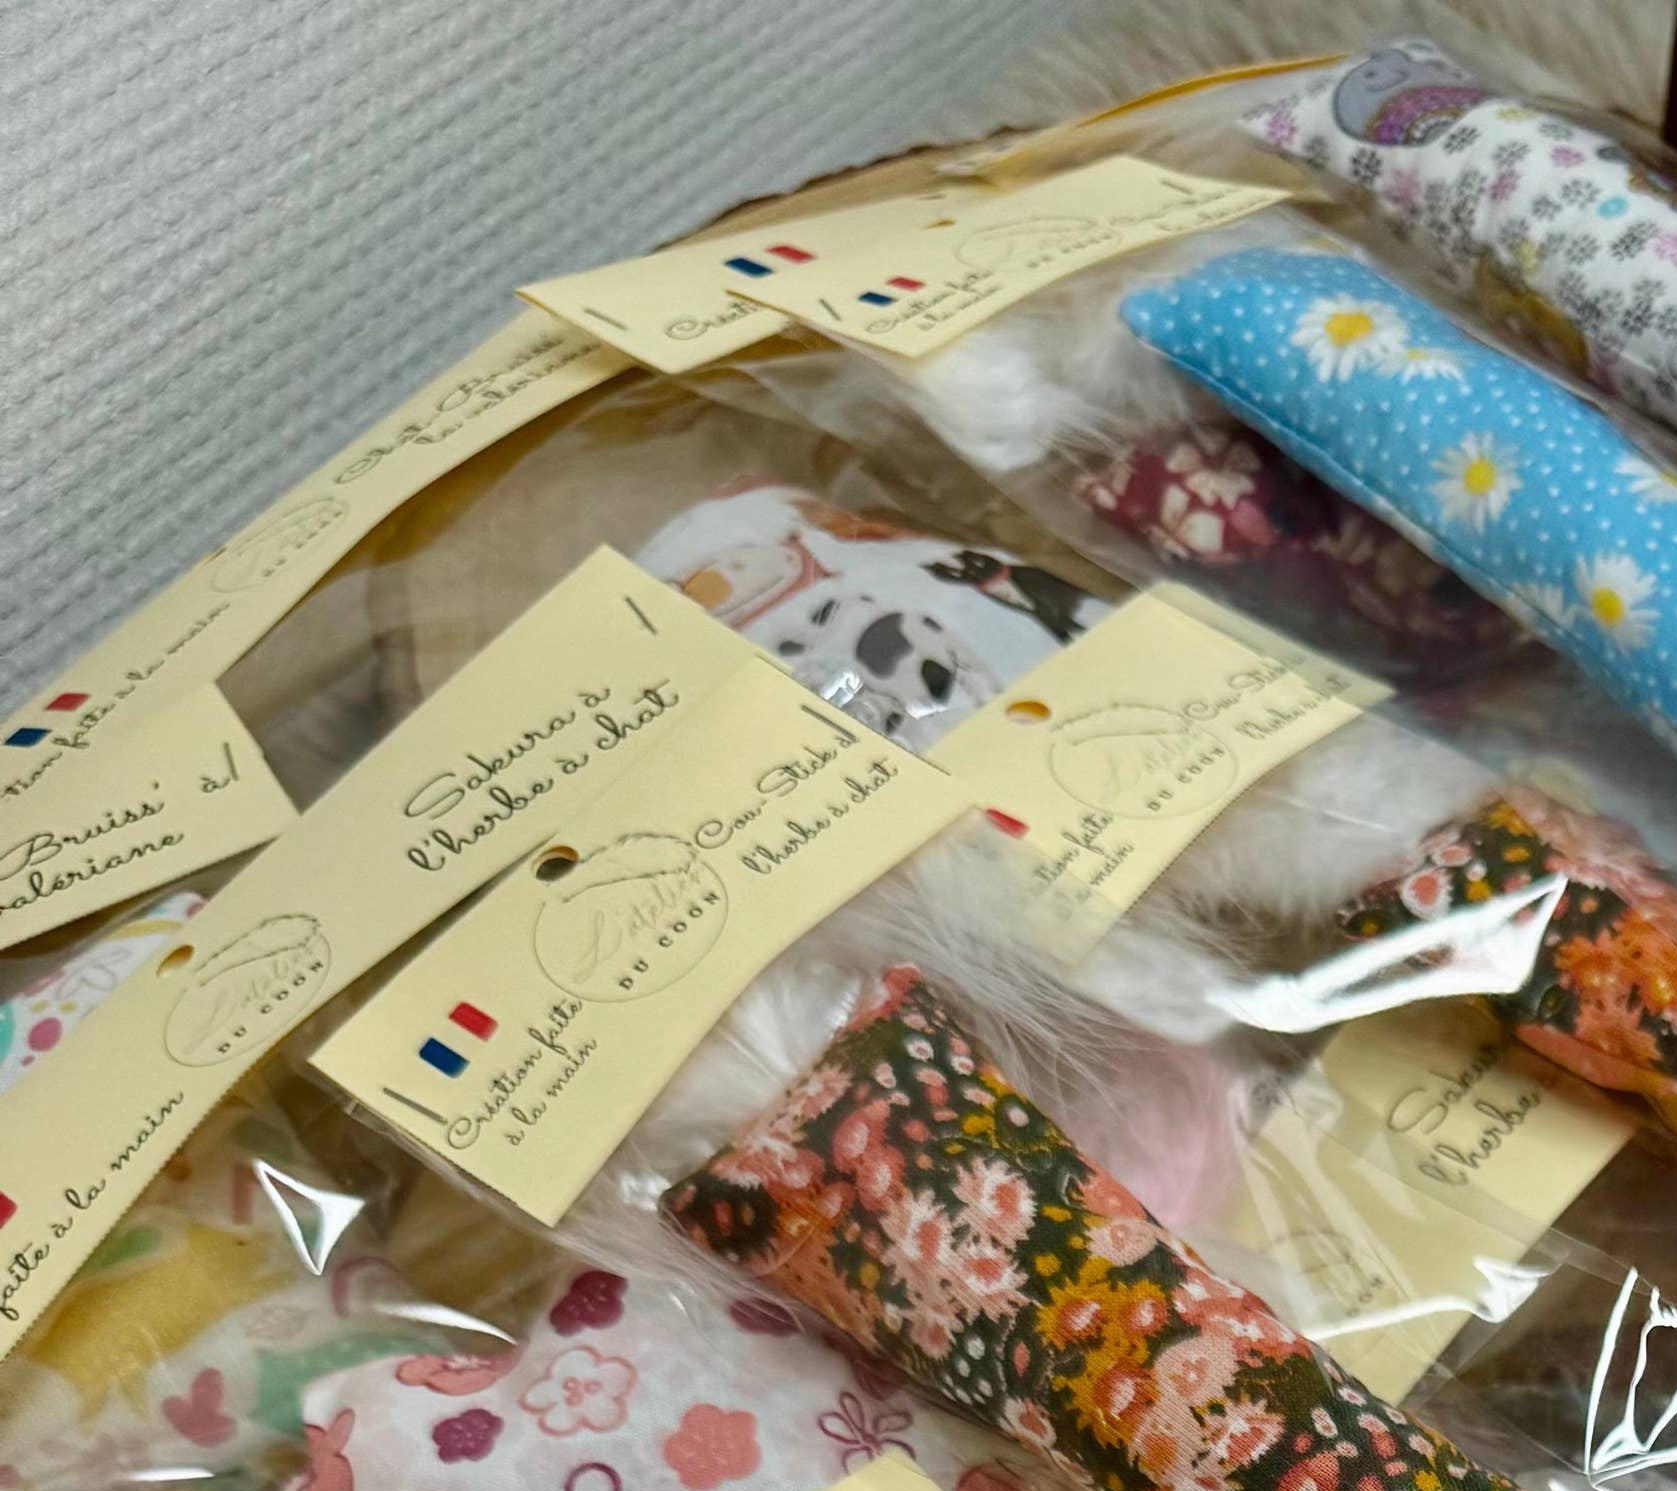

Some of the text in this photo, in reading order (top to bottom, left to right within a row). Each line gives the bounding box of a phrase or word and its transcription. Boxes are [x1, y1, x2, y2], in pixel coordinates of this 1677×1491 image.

[404, 687, 611, 822] Sakura à
[407, 678, 681, 873] l'herbe à chat
[618, 958, 650, 992] DU
[509, 1100, 549, 1126] la
[545, 1038, 599, 1098] main
[50, 1215, 73, 1239] à
[64, 1178, 107, 1211] la
[110, 1091, 185, 1172] main
